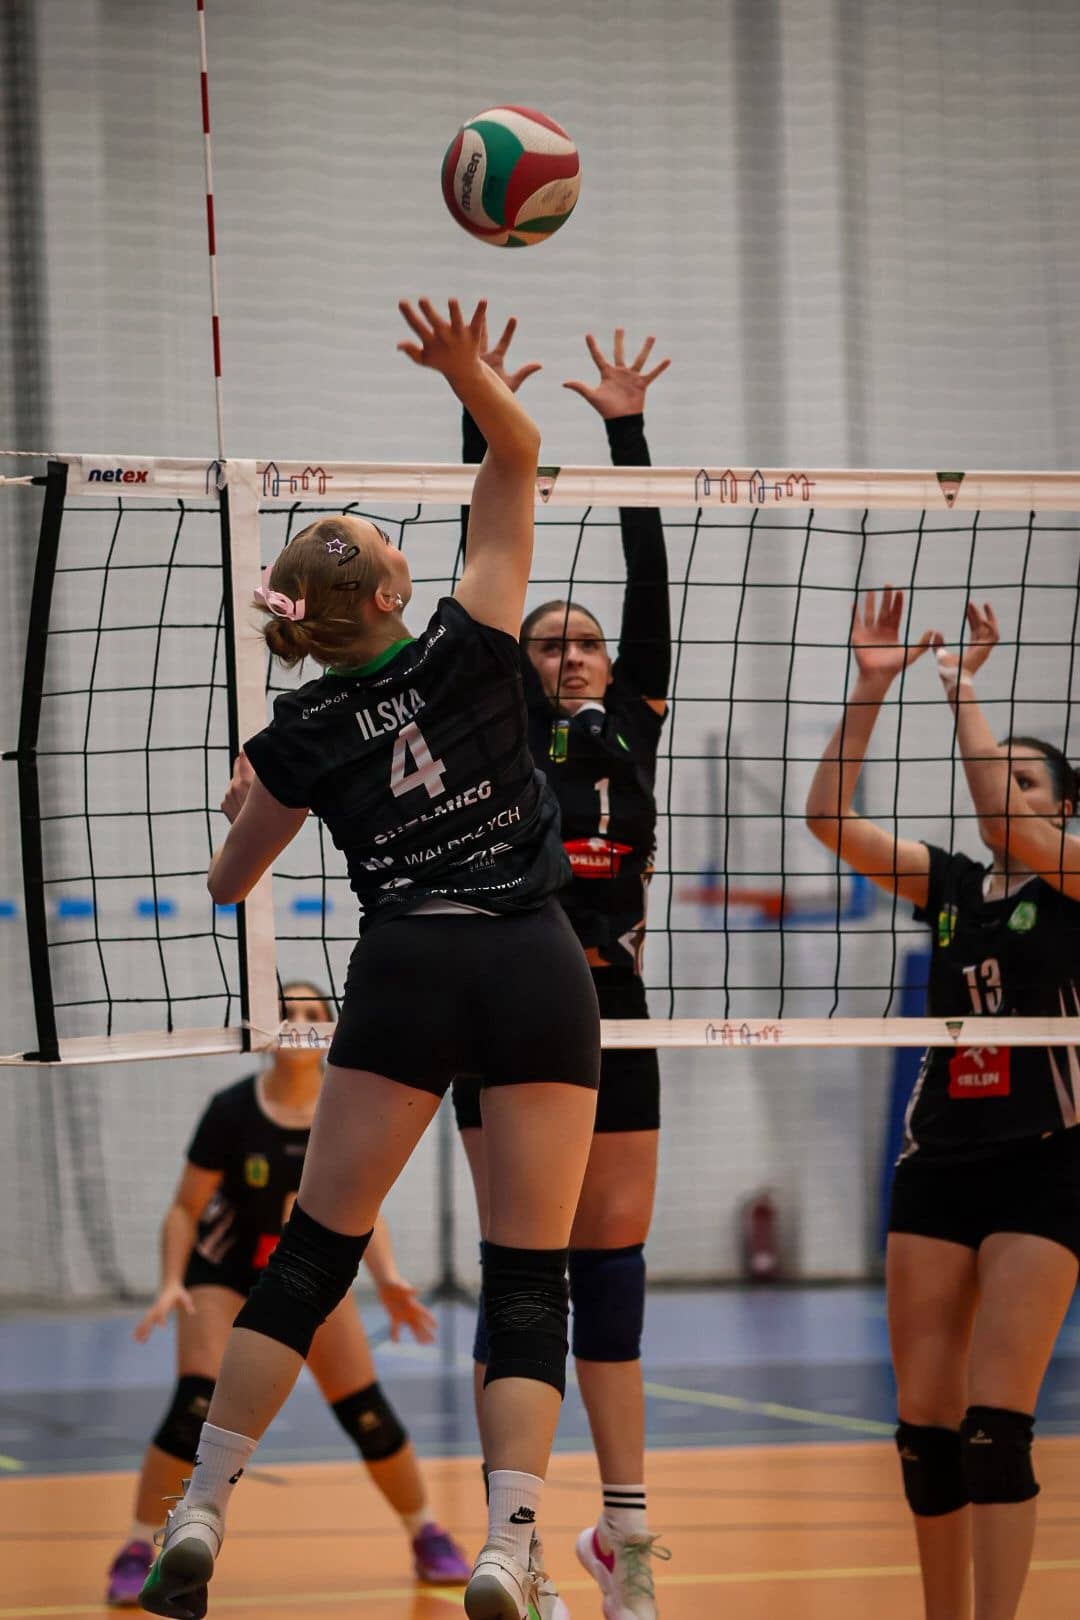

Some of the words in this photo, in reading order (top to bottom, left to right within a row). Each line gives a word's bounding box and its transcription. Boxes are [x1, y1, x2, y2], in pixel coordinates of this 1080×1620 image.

[461, 152, 482, 211] molten
[88, 467, 149, 483] netex
[355, 687, 426, 741] ILSKA
[389, 720, 447, 799] 4
[594, 777, 610, 834] 1
[962, 957, 1003, 1015] 13
